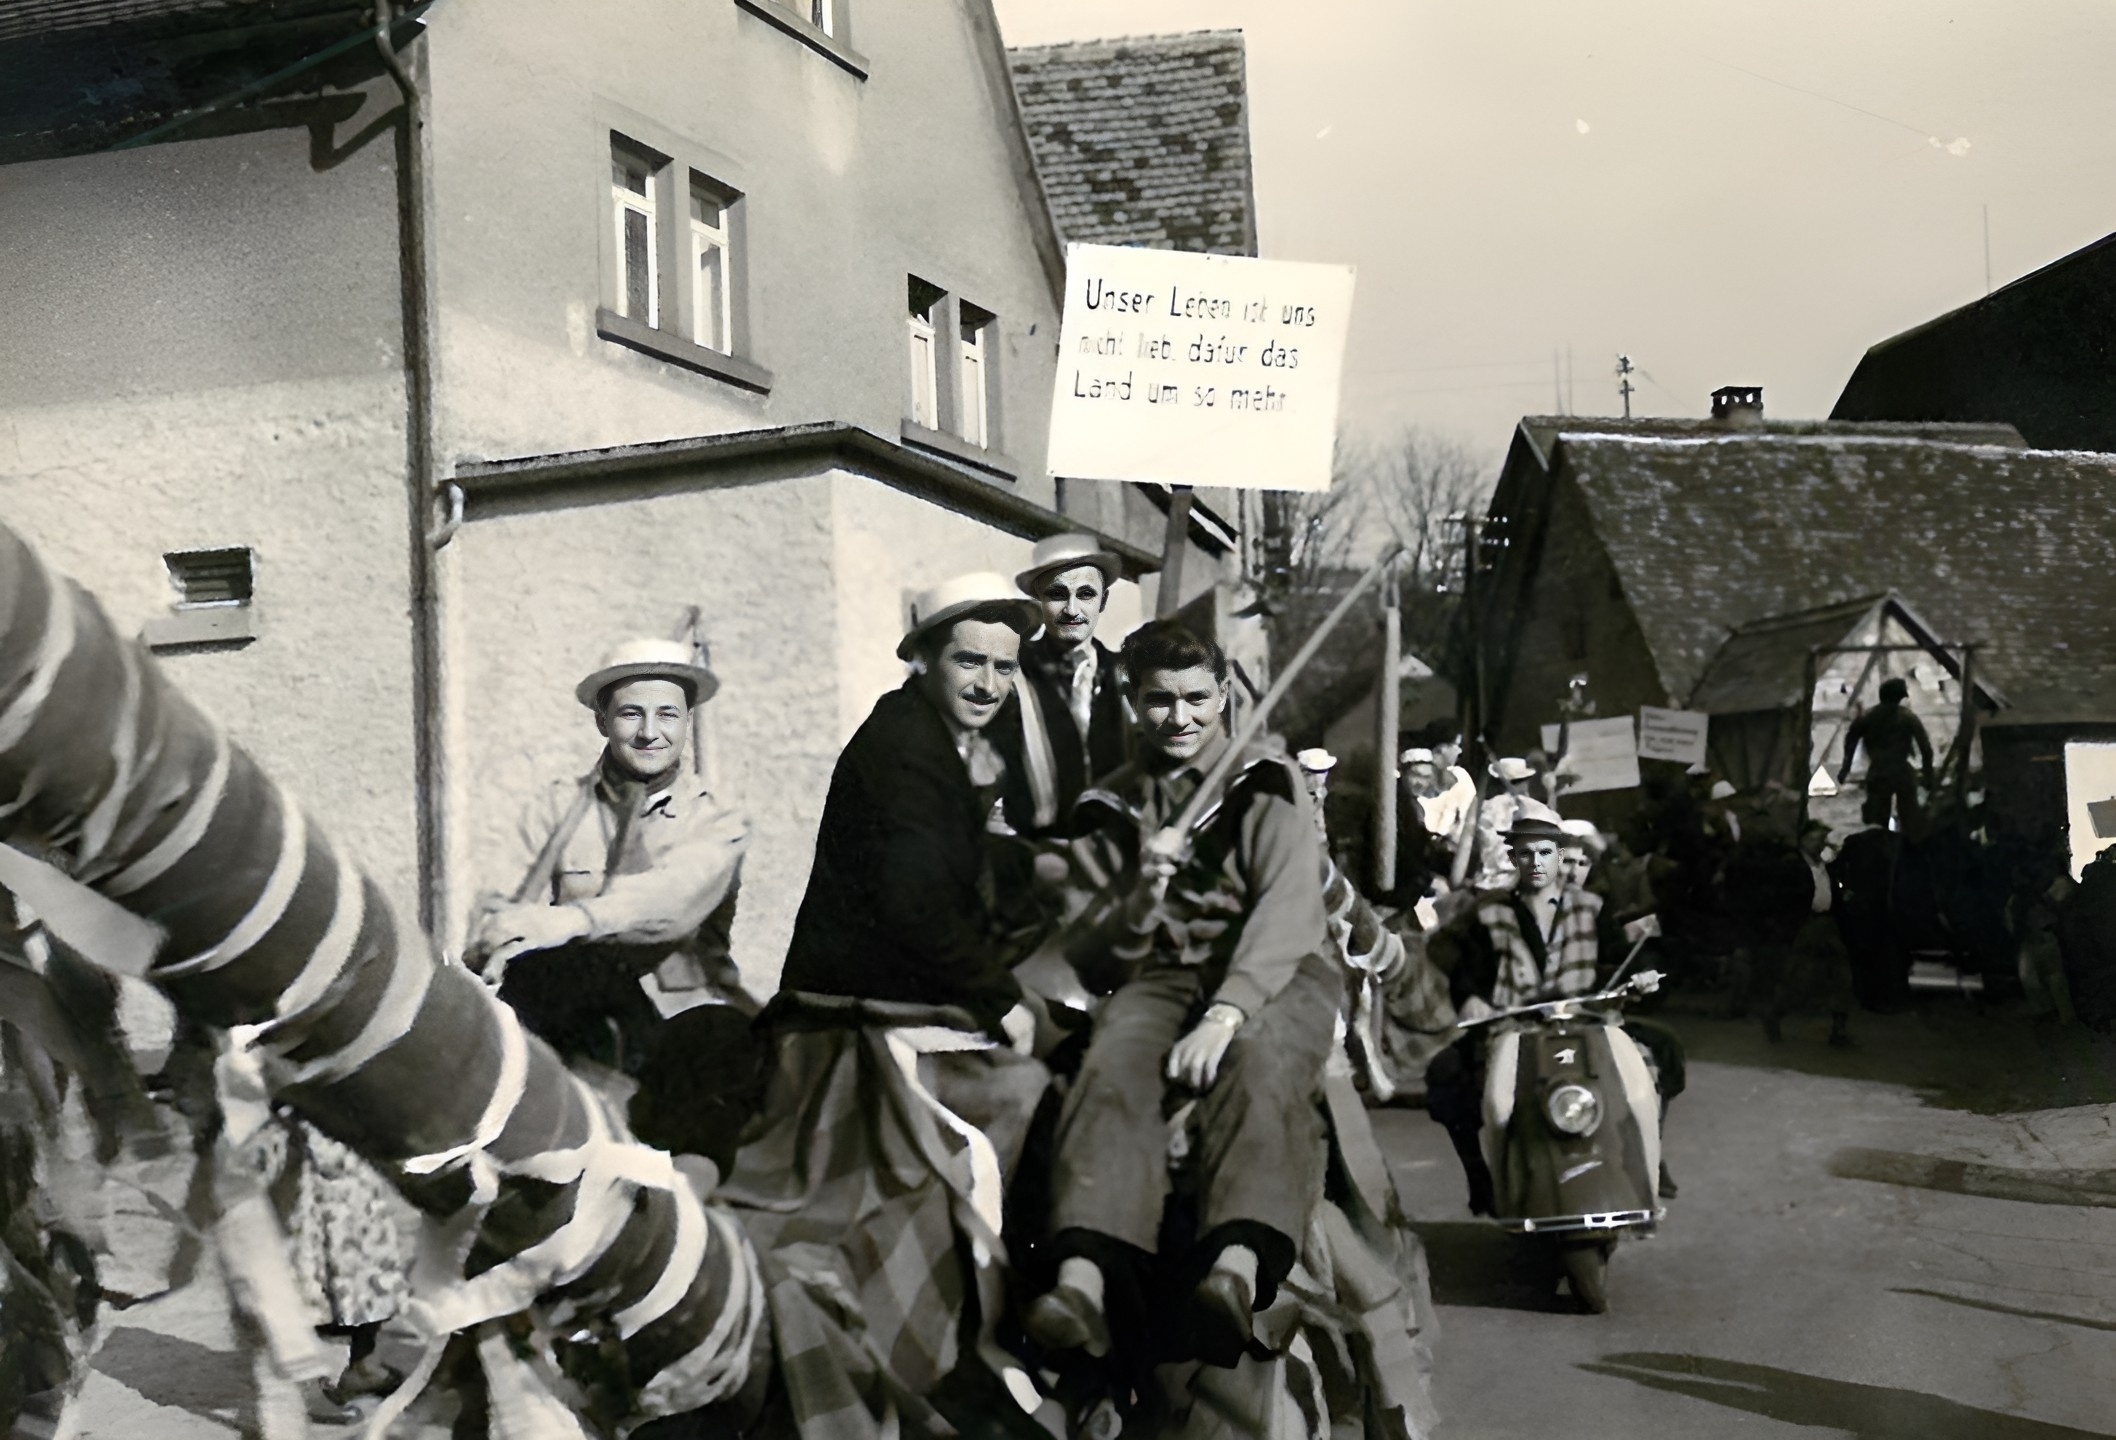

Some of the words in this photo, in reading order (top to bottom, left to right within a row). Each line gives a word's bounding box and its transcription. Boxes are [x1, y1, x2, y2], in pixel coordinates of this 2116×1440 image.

[1086, 278, 1155, 313] Unser
[1281, 304, 1316, 328] uns
[1261, 338, 1299, 369] das
[1074, 369, 1133, 400] Land
[1148, 383, 1179, 404] um
[1193, 385, 1216, 407] so
